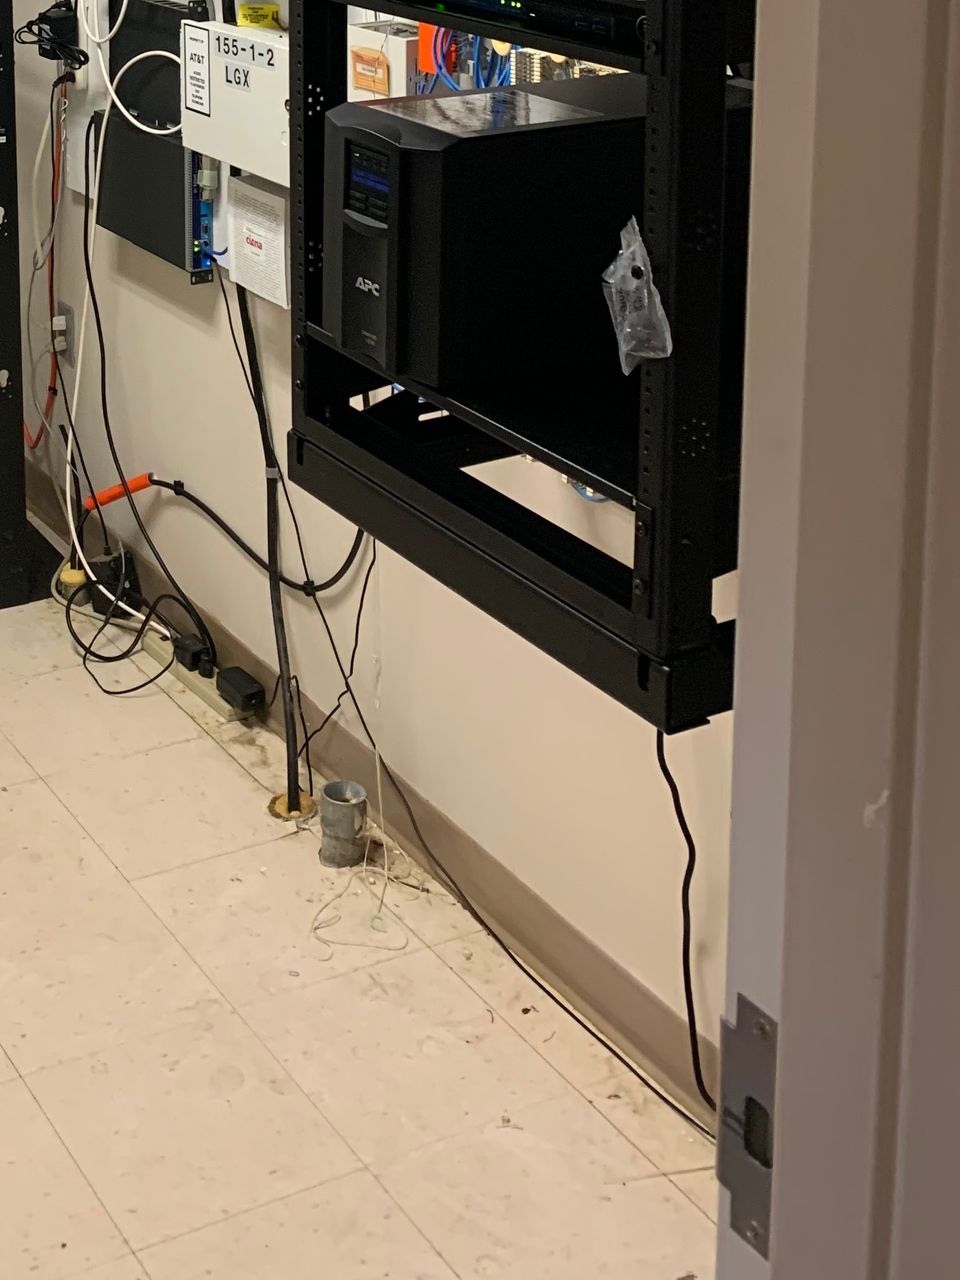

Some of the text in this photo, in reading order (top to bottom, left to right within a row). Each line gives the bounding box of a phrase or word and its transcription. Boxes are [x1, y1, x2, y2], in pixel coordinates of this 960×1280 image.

[189, 52, 205, 65] AT&T
[215, 35, 275, 67] 155-1-2
[225, 65, 250, 88] LGX
[355, 276, 380, 297] APC
